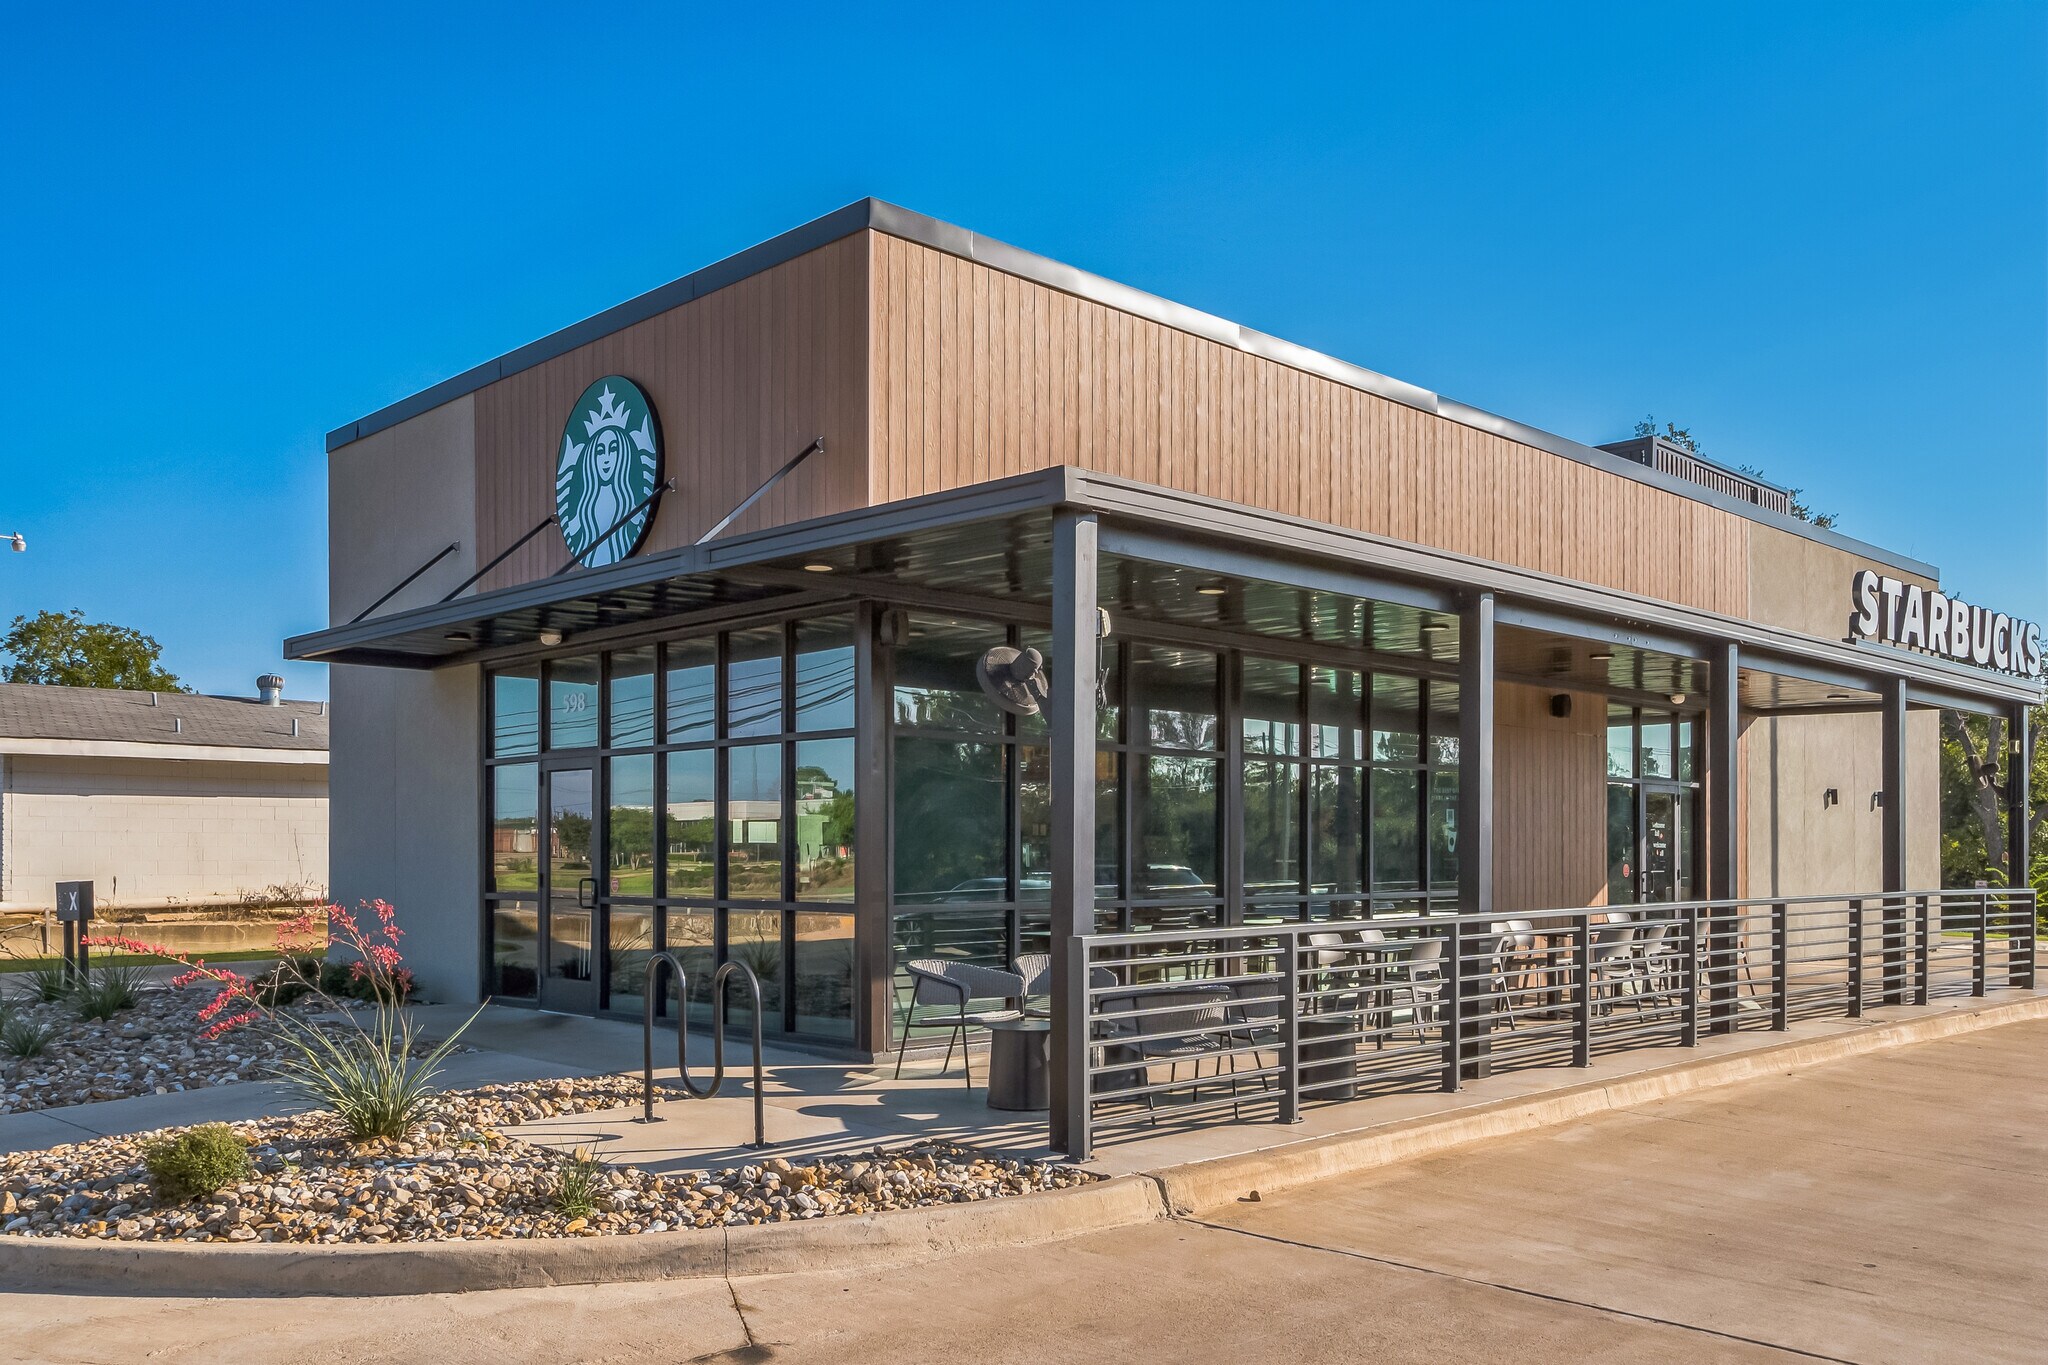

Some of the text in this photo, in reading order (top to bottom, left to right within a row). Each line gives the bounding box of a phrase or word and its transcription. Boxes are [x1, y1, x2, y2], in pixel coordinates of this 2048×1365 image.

[1855, 570, 2041, 676] STARBUCKS
[563, 692, 586, 714] 598
[69, 891, 78, 911] X
